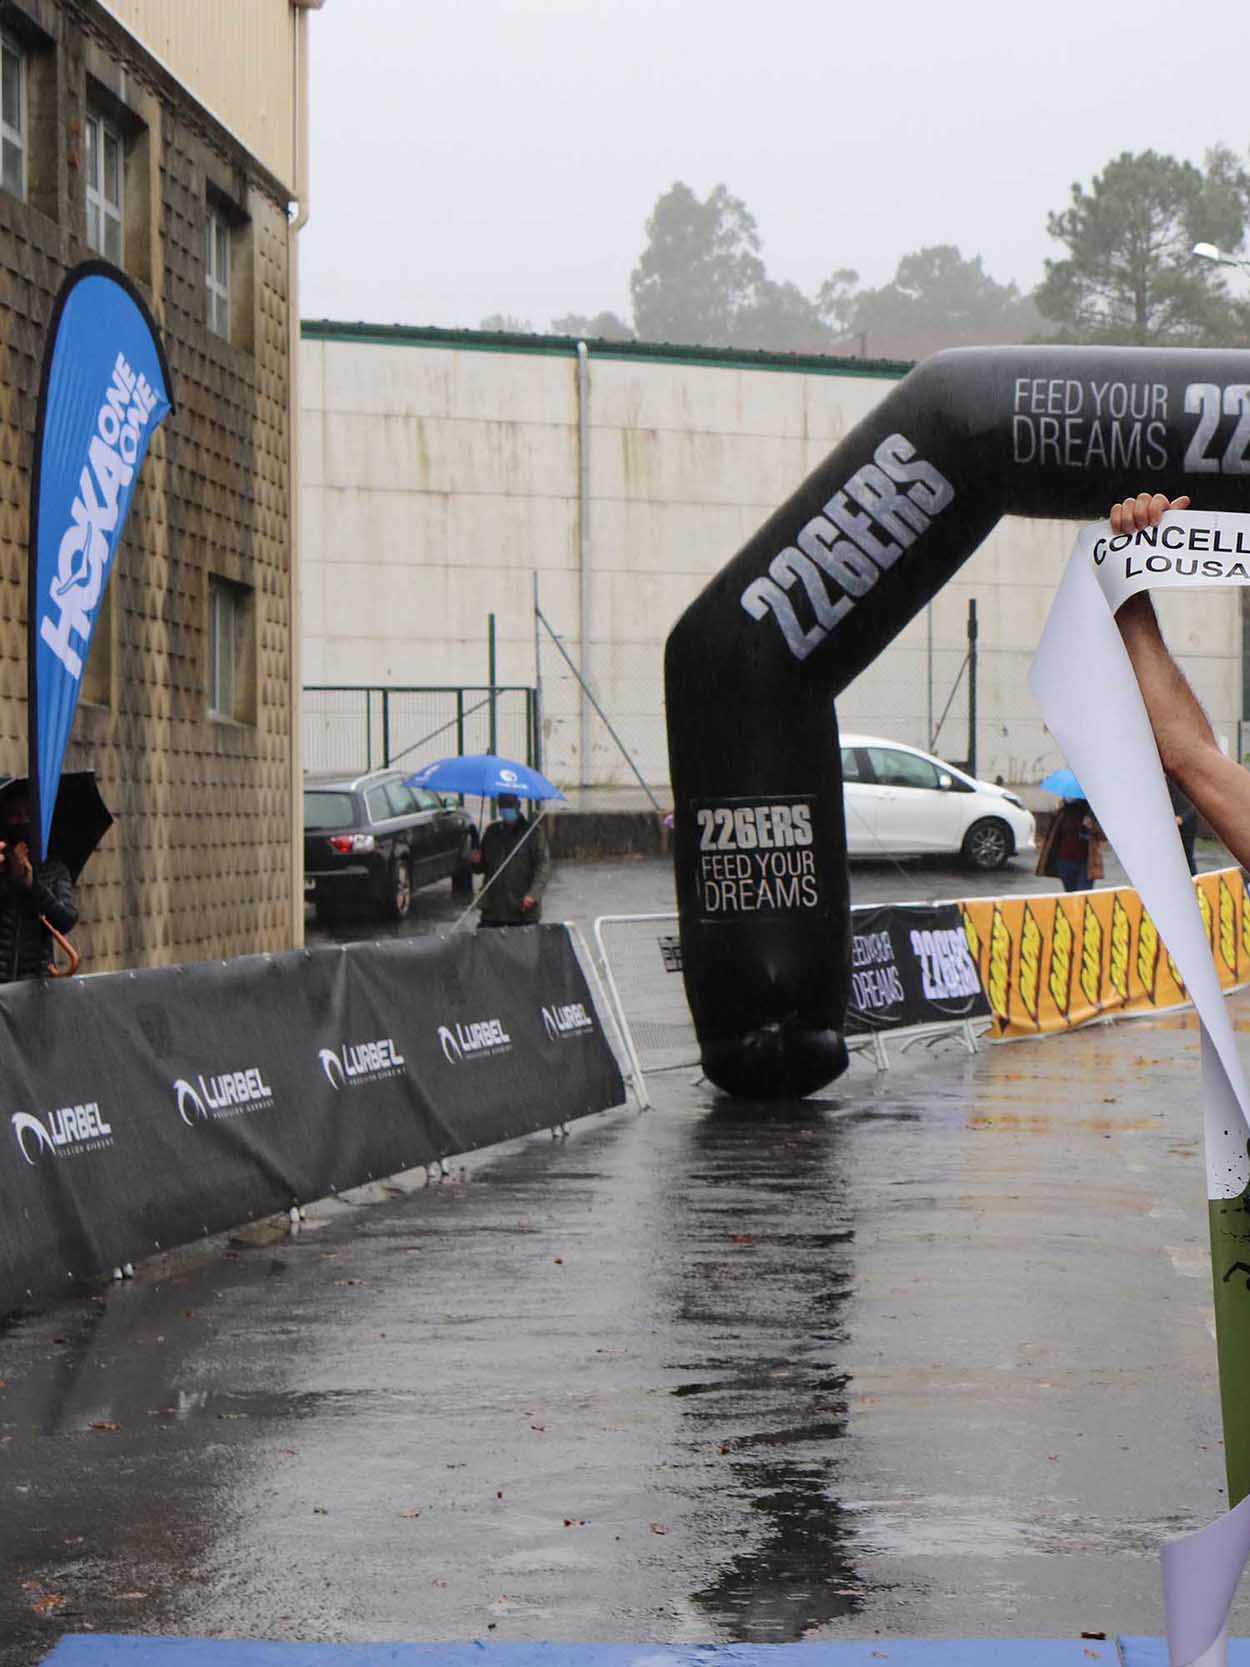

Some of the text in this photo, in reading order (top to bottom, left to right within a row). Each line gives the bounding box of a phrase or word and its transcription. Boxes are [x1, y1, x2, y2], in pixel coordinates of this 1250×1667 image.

[98, 351, 137, 446] ONE
[120, 372, 158, 465] ONE
[1013, 378, 1169, 421] FEED YOUR
[1011, 414, 1169, 472] DREAMS
[40, 434, 134, 681] HOKA
[740, 433, 955, 661] 226ERS
[696, 804, 814, 850] 226ERS
[701, 850, 816, 880] FEED YOUR
[703, 874, 819, 912] DREAMS
[455, 1018, 512, 1050] LURBEL
[551, 1003, 593, 1031] LURBEL
[341, 1038, 405, 1076] LURBEL
[198, 1067, 273, 1109] LURBEL
